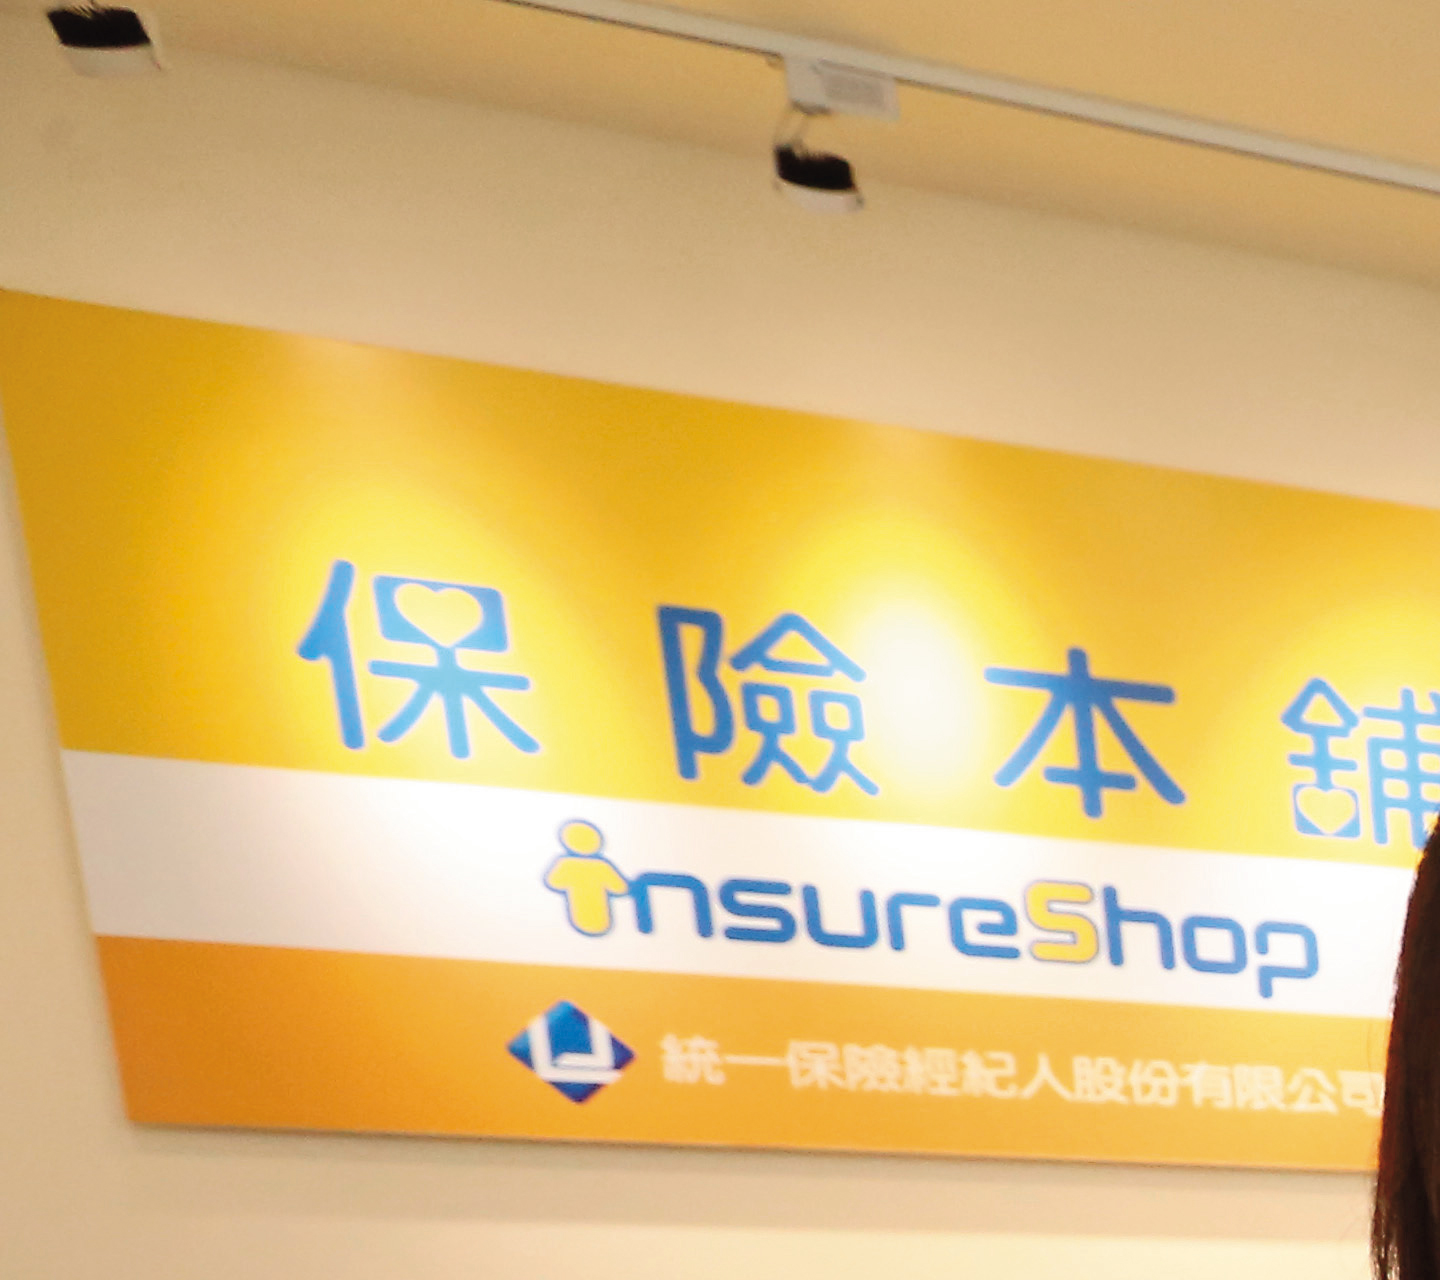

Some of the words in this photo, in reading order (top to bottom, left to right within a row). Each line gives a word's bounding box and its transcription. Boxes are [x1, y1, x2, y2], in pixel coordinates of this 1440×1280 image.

[543, 818, 1320, 998] insureShop
[660, 1031, 1390, 1120] 統一保險經紀人股份有限公司
